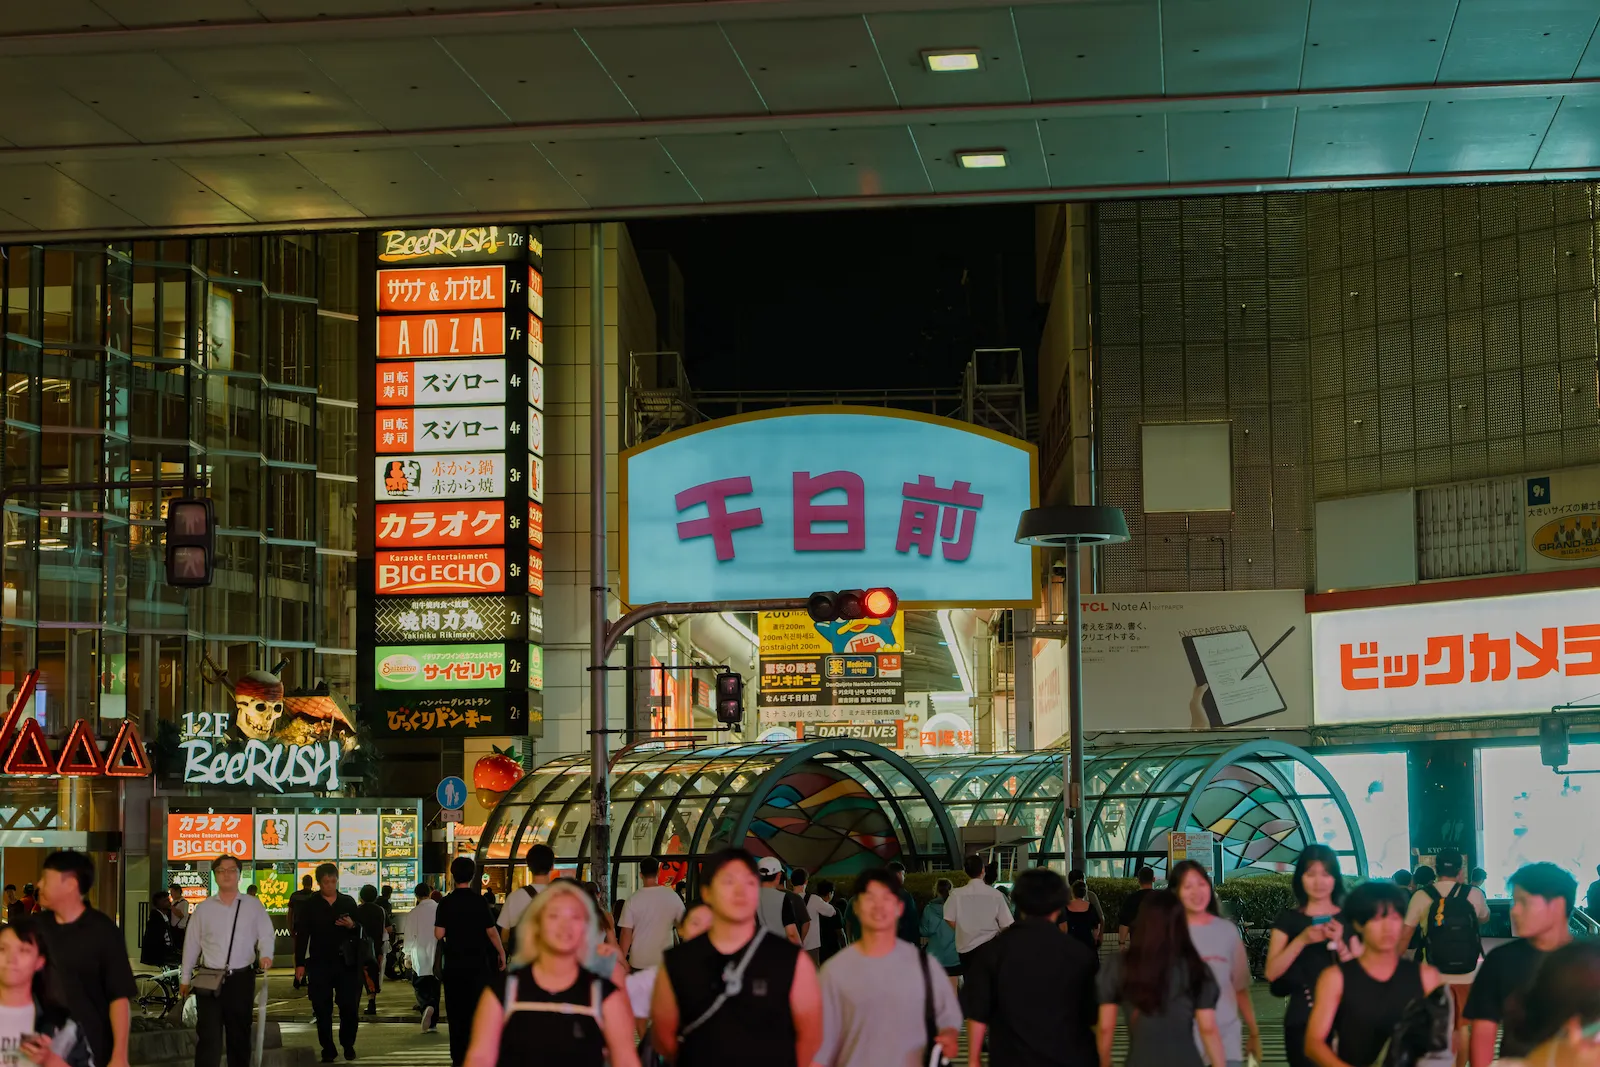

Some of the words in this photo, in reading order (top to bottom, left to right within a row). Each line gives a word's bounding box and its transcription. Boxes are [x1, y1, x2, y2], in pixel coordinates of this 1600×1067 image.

[508, 233, 524, 246] 12F
[387, 278, 426, 302] サウナ
[429, 282, 440, 301] &
[444, 275, 496, 301] カプセル
[510, 280, 521, 293] 7F
[398, 318, 485, 355] AMZA
[510, 327, 521, 340] 7F
[383, 371, 409, 384] 回転
[421, 373, 499, 393] スシロー
[510, 374, 521, 387] 4F
[383, 385, 409, 398] 寿司
[382, 418, 409, 431] 回転
[420, 420, 499, 440] スシロー
[510, 421, 521, 434] 4F
[382, 432, 408, 445] 寿司
[431, 460, 494, 477] 赤から鍋
[509, 468, 521, 481] 3F
[431, 478, 494, 495] 赤から焼
[1532, 484, 1545, 497] 9F
[509, 516, 521, 529] 3F
[674, 470, 984, 562] 千日前
[378, 511, 501, 539] カラオケ
[426, 553, 488, 561] Entertainment
[379, 565, 426, 589] BIG
[431, 562, 501, 586] ECHO
[509, 564, 521, 577] 3F
[1080, 602, 1109, 612] TCL
[1112, 602, 1138, 611] Note
[398, 610, 484, 631] 焼肉力丸
[510, 612, 521, 625] 2F
[1081, 622, 1147, 631] 考えを深め、書く、
[439, 631, 475, 639] Rikimaru
[1081, 632, 1141, 641] クリエイトする。
[770, 643, 799, 652] straight
[1340, 623, 1600, 690] ビックカメラ
[423, 662, 503, 680] サイゼリヤ
[510, 659, 521, 672] 2F
[419, 698, 491, 706] ハンバーグレストラン
[765, 694, 817, 702] なんば千日前店
[387, 706, 492, 731] びっくりドンキー
[510, 707, 521, 720] 2F
[182, 711, 230, 738] 12F
[818, 725, 897, 738] DARTSLIVE3
[178, 739, 340, 793] BeeRUSH
[179, 815, 242, 832] カラオケ
[303, 832, 333, 841] スシロー
[173, 840, 202, 857] BIG
[204, 839, 247, 856] ECHO
[259, 877, 289, 895] びっくり
[258, 893, 290, 908] ドンキー
